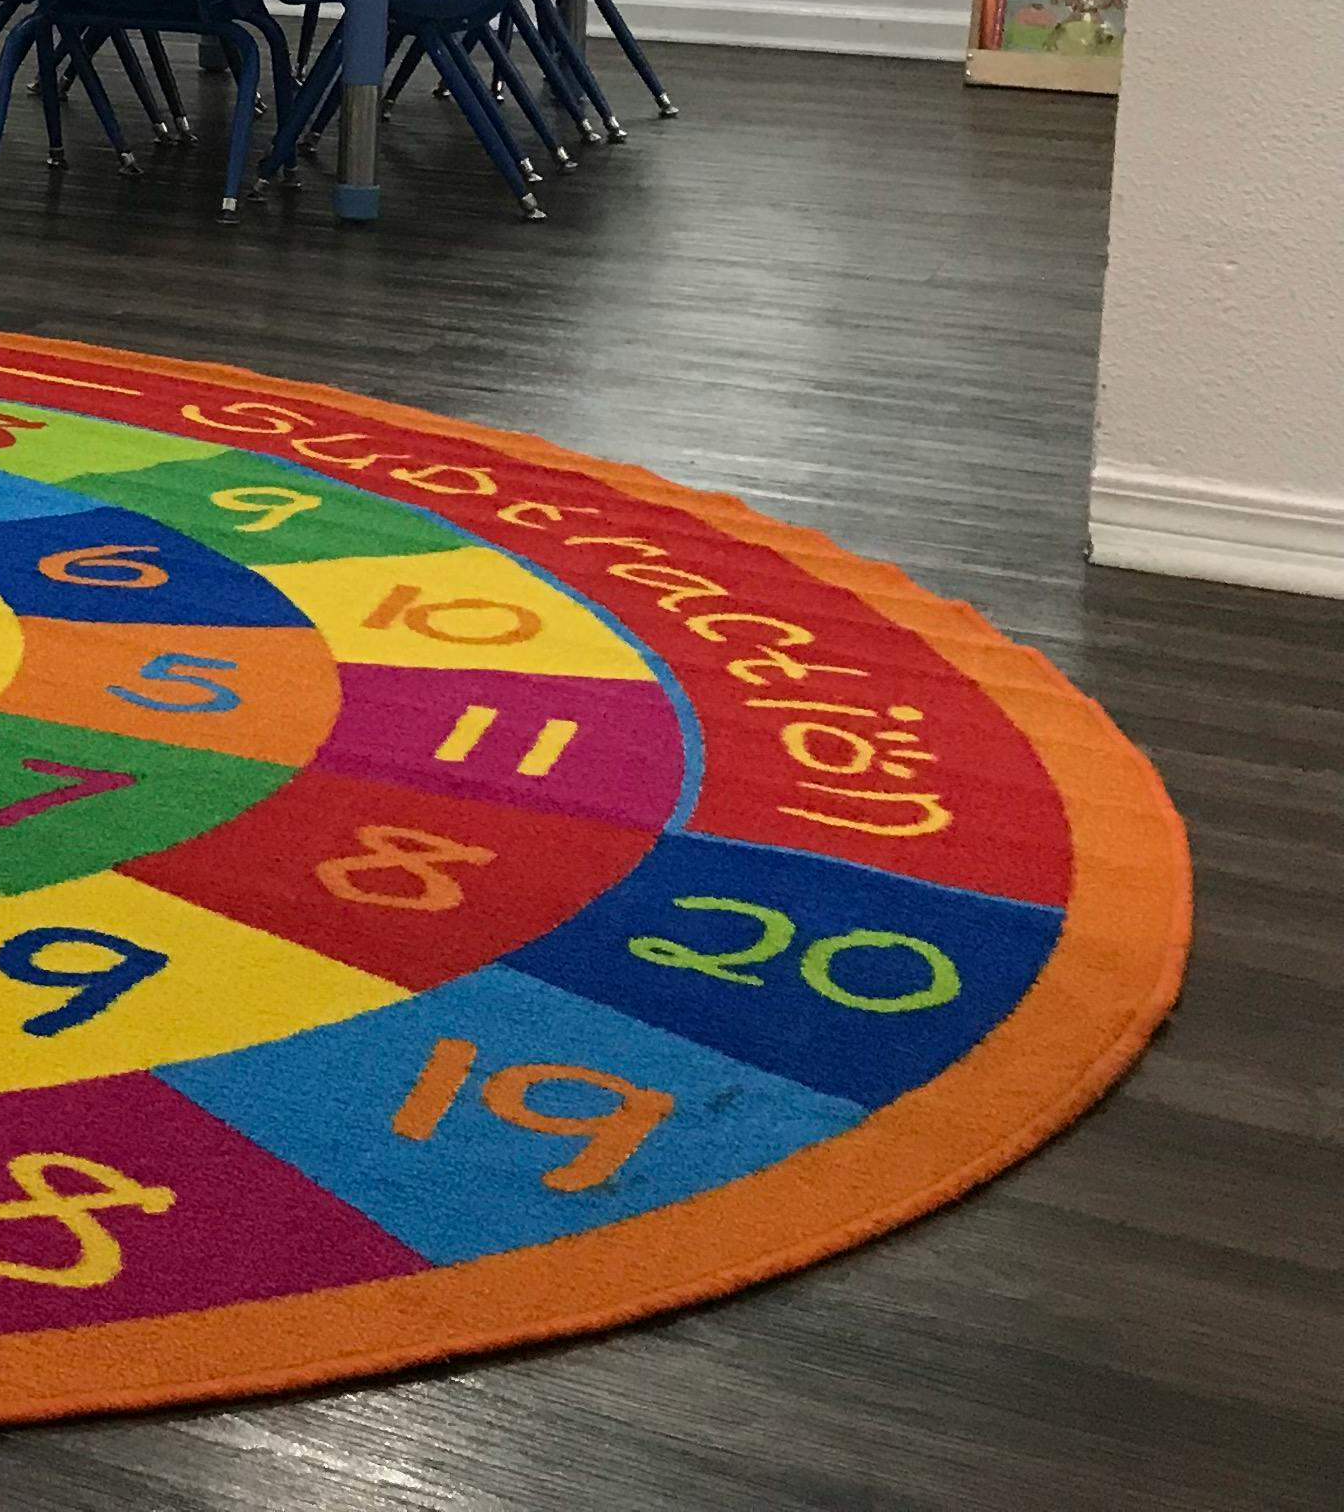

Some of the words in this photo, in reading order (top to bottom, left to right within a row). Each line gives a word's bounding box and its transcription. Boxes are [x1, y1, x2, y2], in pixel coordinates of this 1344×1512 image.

[210, 485, 323, 533] 9
[37, 544, 171, 589] 6
[360, 583, 545, 646] 10
[106, 653, 242, 714] 5
[434, 704, 580, 778] 11
[314, 824, 499, 912] 8
[626, 895, 964, 1015] 20
[390, 1037, 677, 1193] 19
